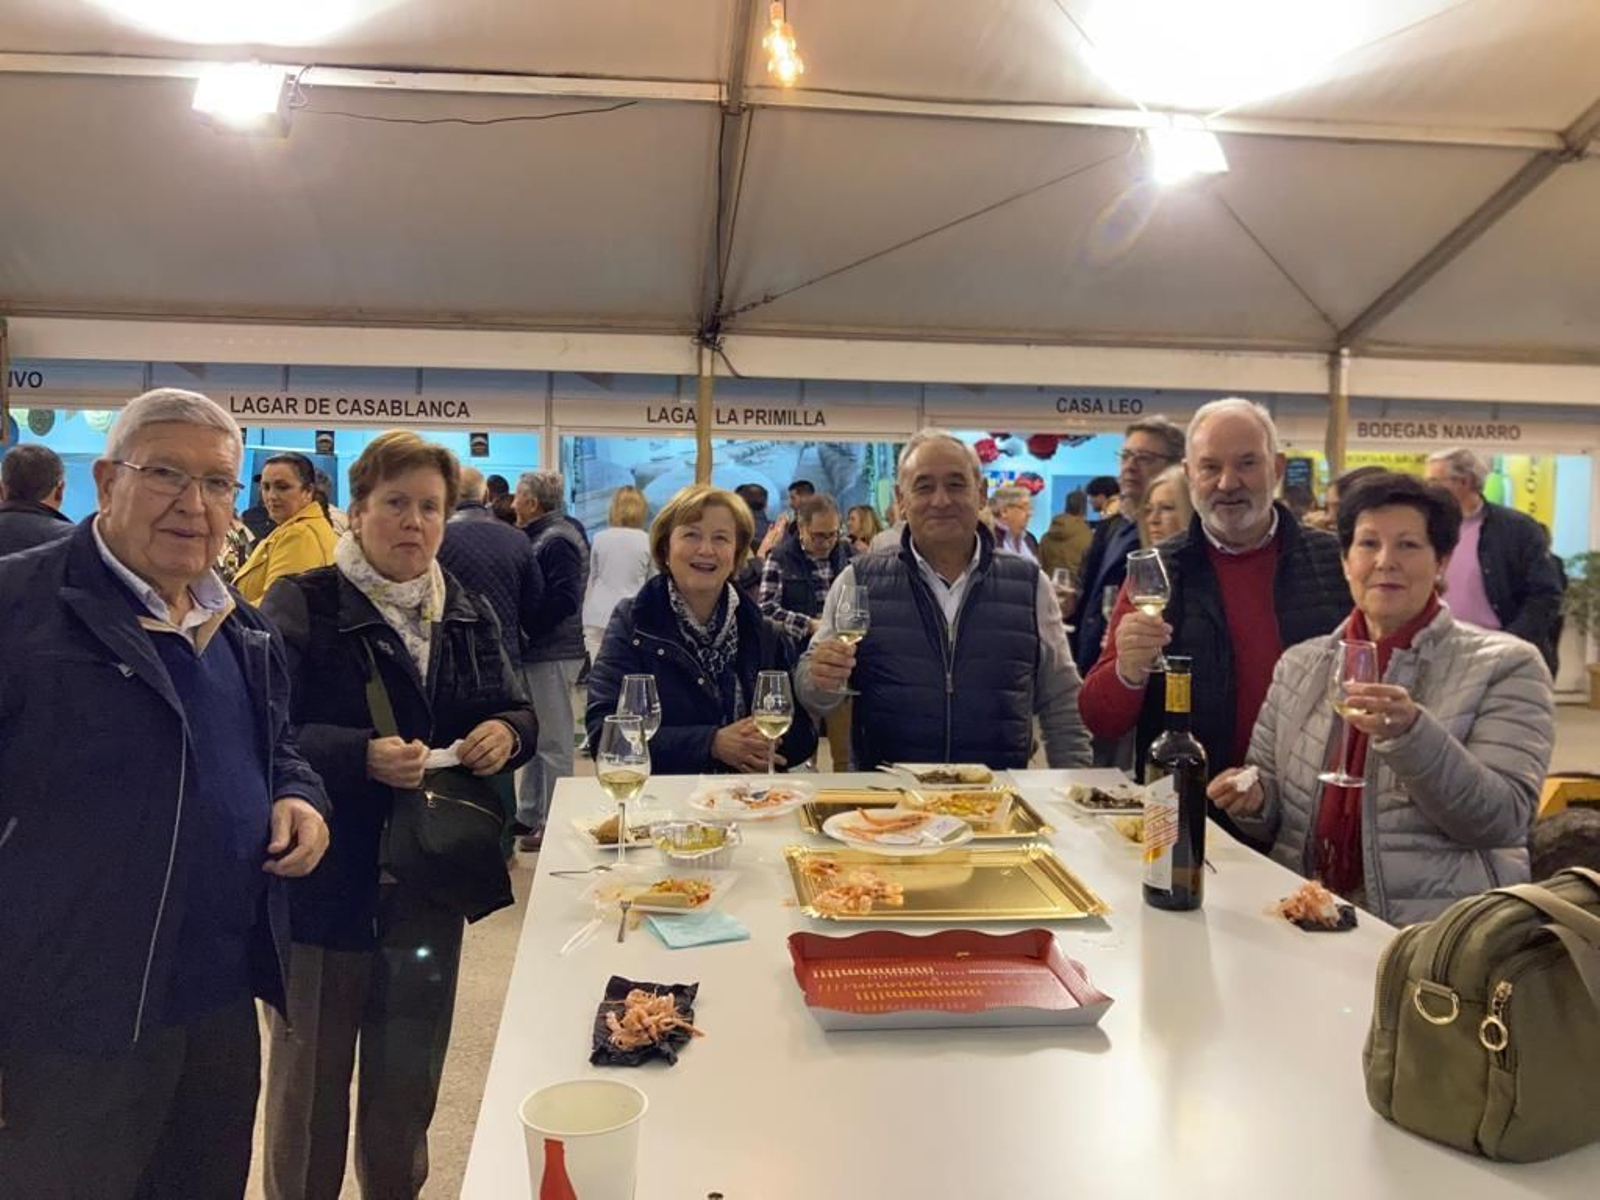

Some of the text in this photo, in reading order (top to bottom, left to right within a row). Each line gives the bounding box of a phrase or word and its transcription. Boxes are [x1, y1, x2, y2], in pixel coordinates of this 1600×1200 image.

[8, 370, 43, 388] IVO
[230, 396, 470, 418] LAGAR DE CASABLANCA
[1056, 397, 1143, 414] CASA LEO
[646, 407, 826, 426] LAGA LA PRIMILLA
[1357, 422, 1521, 440] BODEGAS NAVARRO
